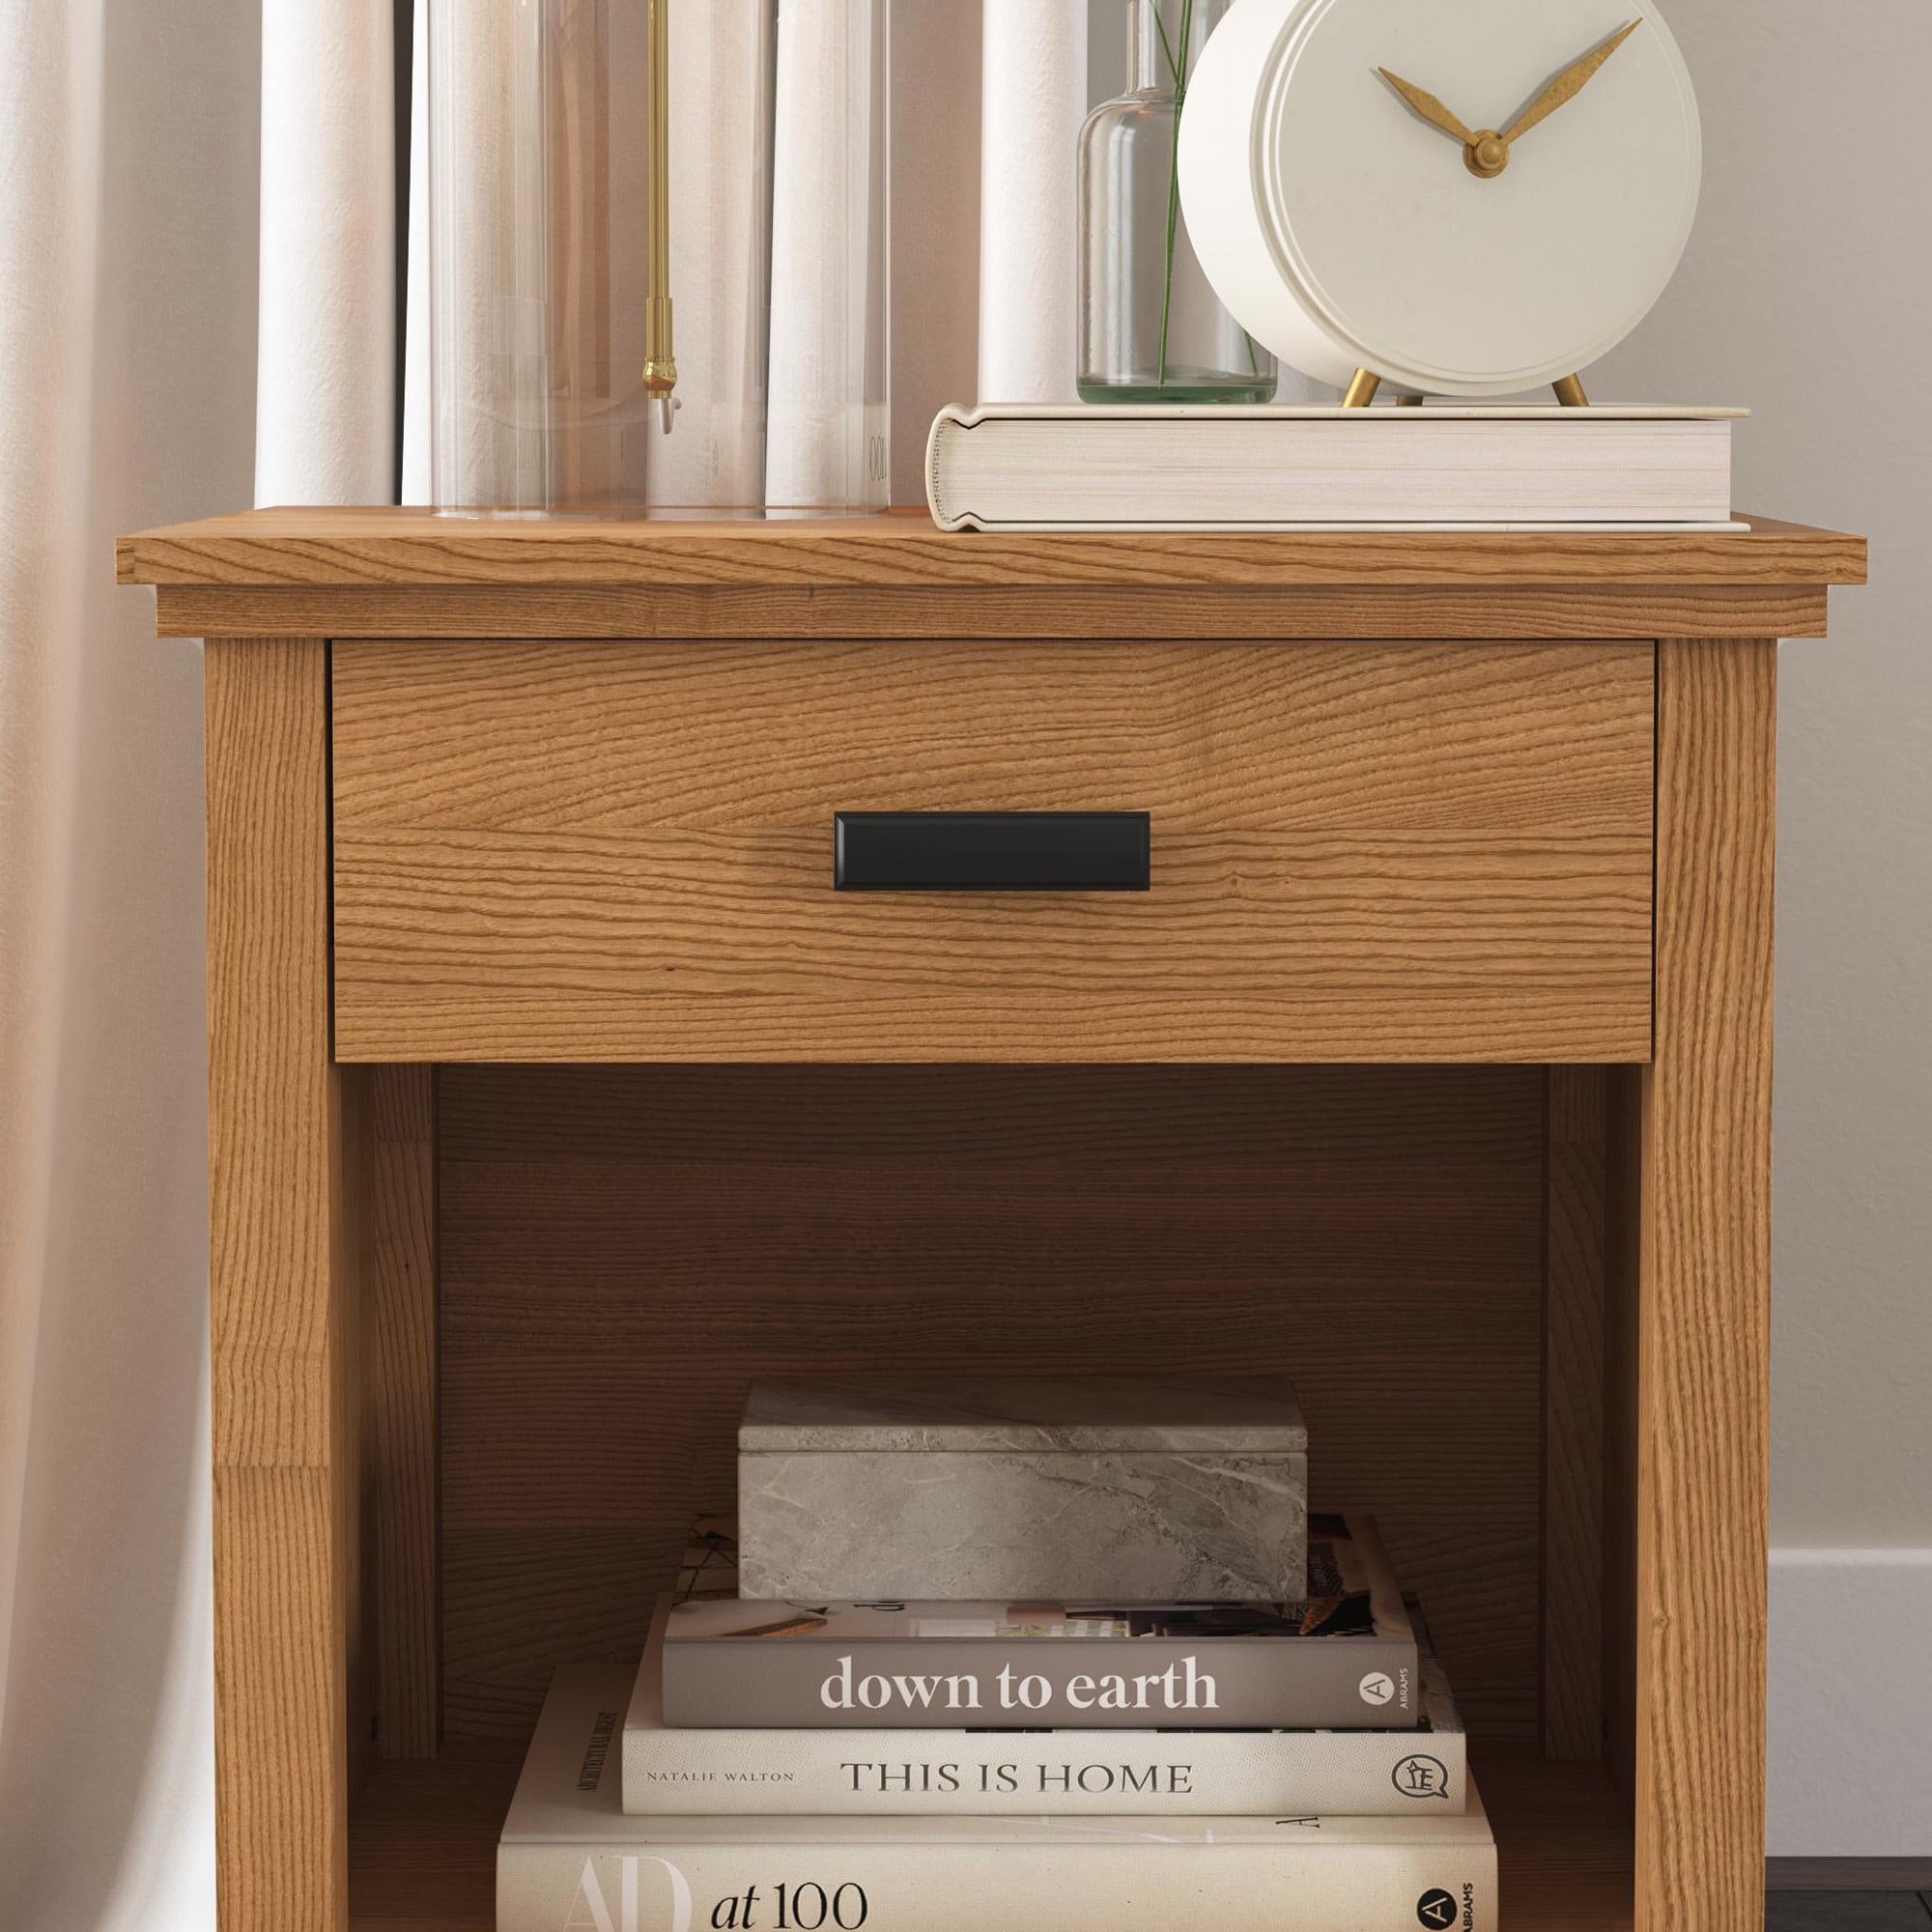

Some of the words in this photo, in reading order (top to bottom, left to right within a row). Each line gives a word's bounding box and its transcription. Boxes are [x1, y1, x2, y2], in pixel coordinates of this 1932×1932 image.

[820, 1655, 982, 1709] down
[995, 1662, 1053, 1709] to
[1065, 1655, 1220, 1709] earth
[1399, 1667, 1408, 1710] ABRAMS
[646, 1772, 718, 1781] NATALIE
[724, 1772, 794, 1781] WALTON
[839, 1763, 960, 1792] THIS
[978, 1763, 1018, 1793] IS
[1037, 1763, 1193, 1794] HOME
[563, 1855, 693, 1932] AD
[710, 1885, 760, 1930] at
[773, 1881, 868, 1931] 100
[1463, 1883, 1474, 1932] ABRAMS
